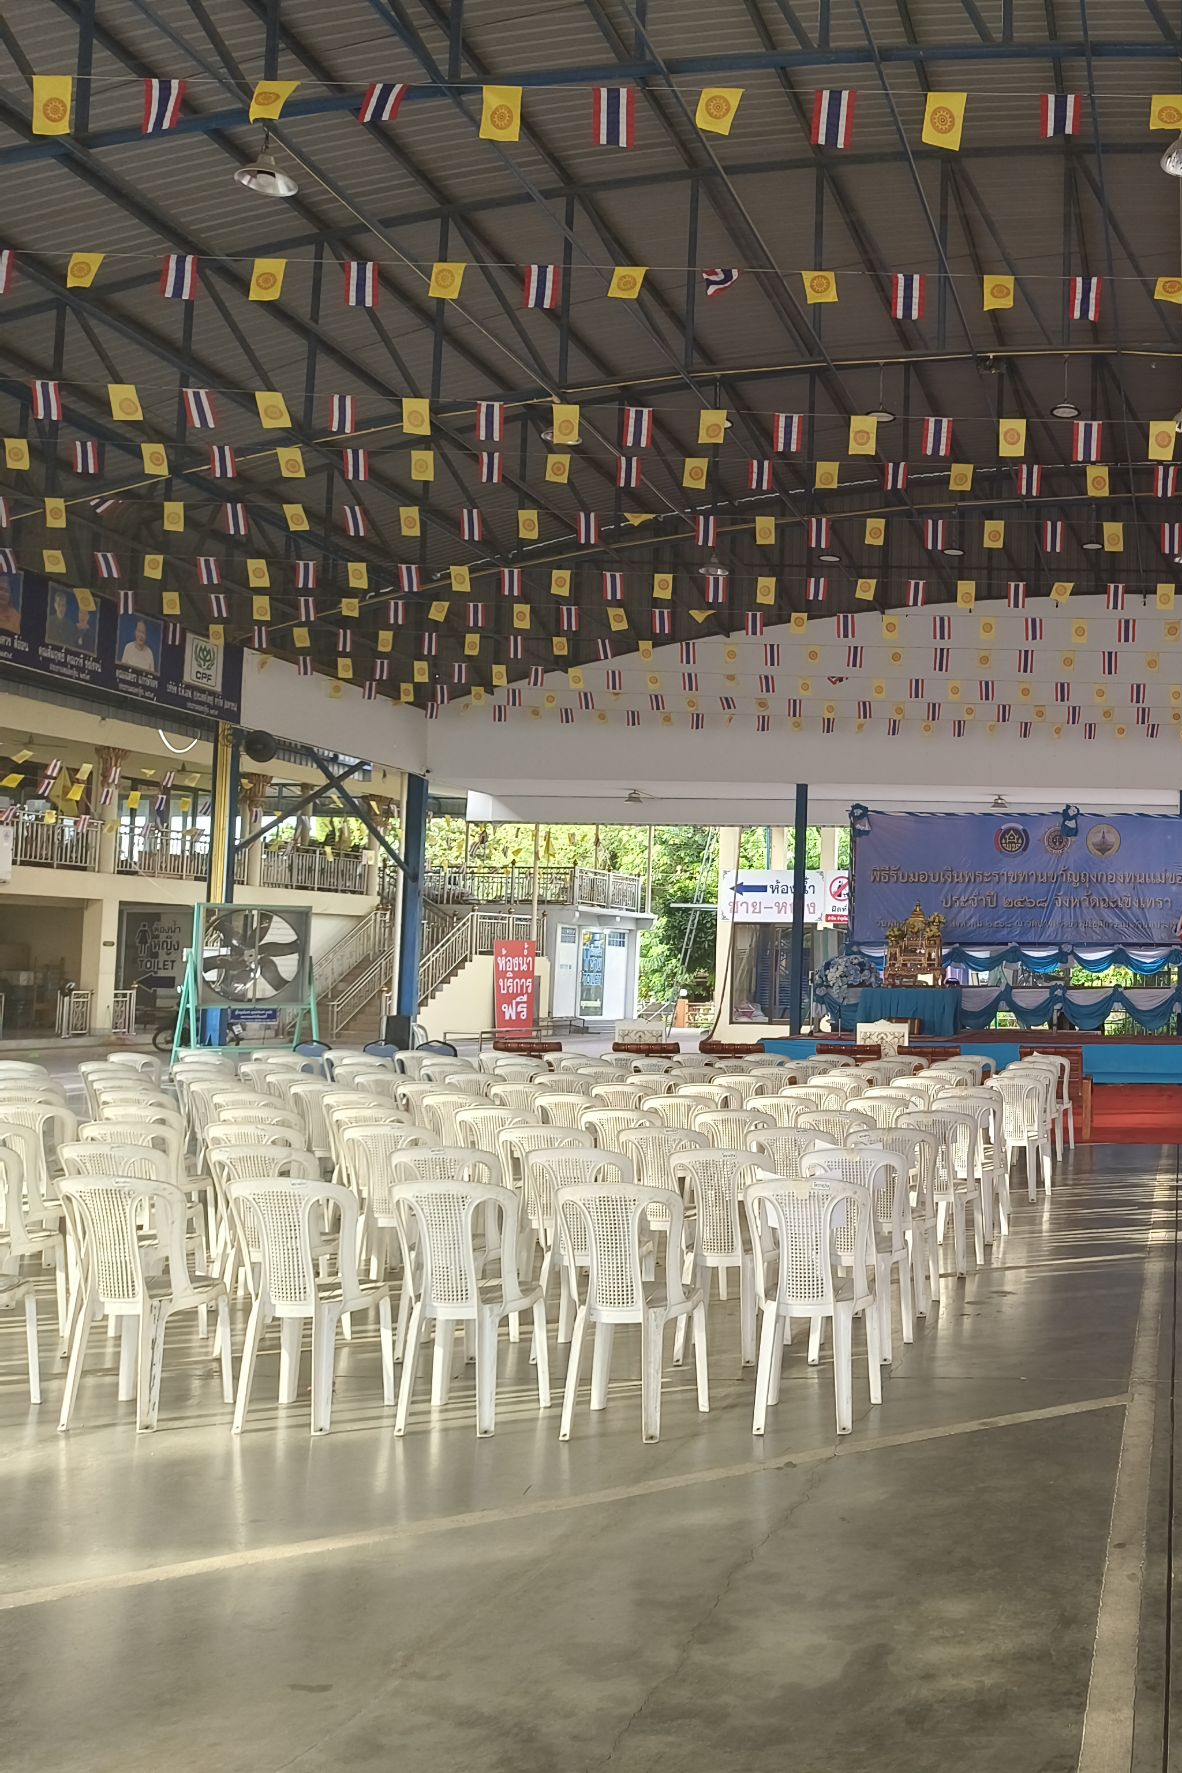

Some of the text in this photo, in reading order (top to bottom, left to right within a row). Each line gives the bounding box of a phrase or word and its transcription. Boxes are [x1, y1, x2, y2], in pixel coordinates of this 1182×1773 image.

[195, 670, 213, 682] CPF
[942, 891, 998, 909] ประจำปี
[1002, 893, 1048, 908] ๒๕๖๘
[138, 959, 176, 971] TOILET
[497, 942, 533, 971] ห้องน้ำ
[499, 971, 533, 994] บริการ
[502, 993, 528, 1021] ฟรี
